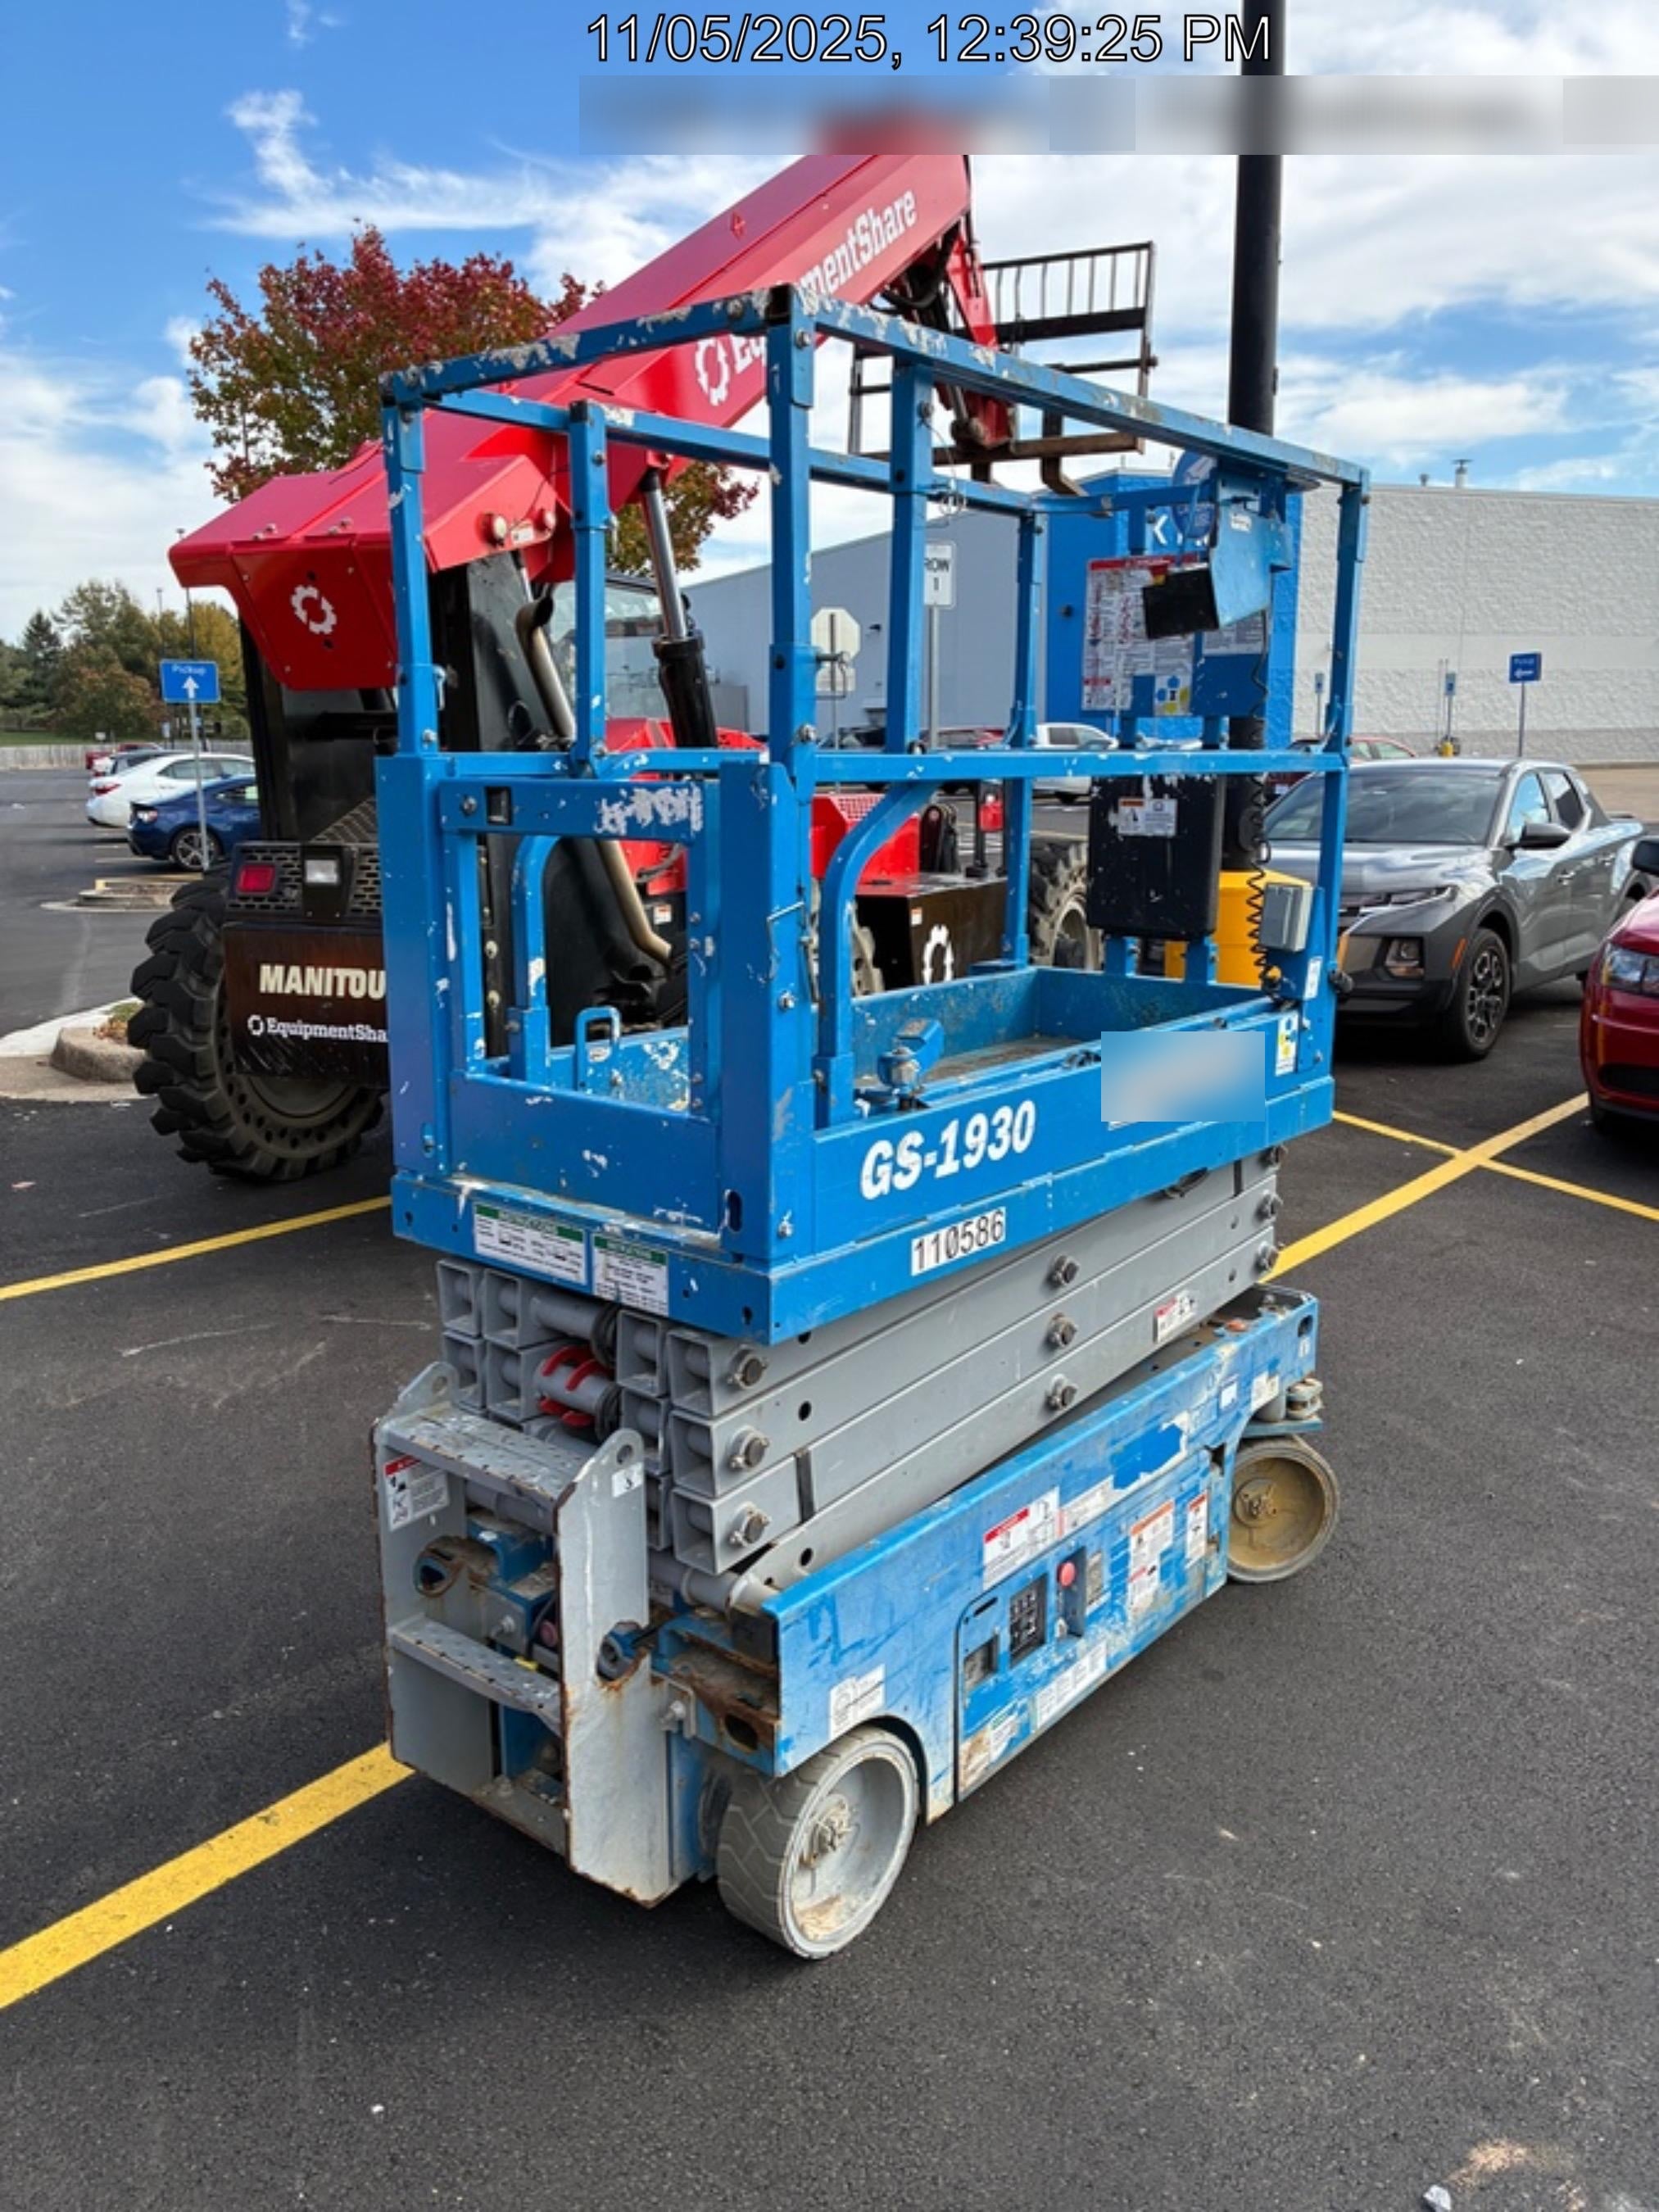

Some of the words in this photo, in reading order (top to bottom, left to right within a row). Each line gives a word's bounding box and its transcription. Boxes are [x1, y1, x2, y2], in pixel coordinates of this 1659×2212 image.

[259, 963, 388, 999] MANITOU
[266, 1016, 390, 1043] EquipmentSha
[860, 1099, 1036, 1200] GS-1930
[913, 1208, 1004, 1271] 110586
